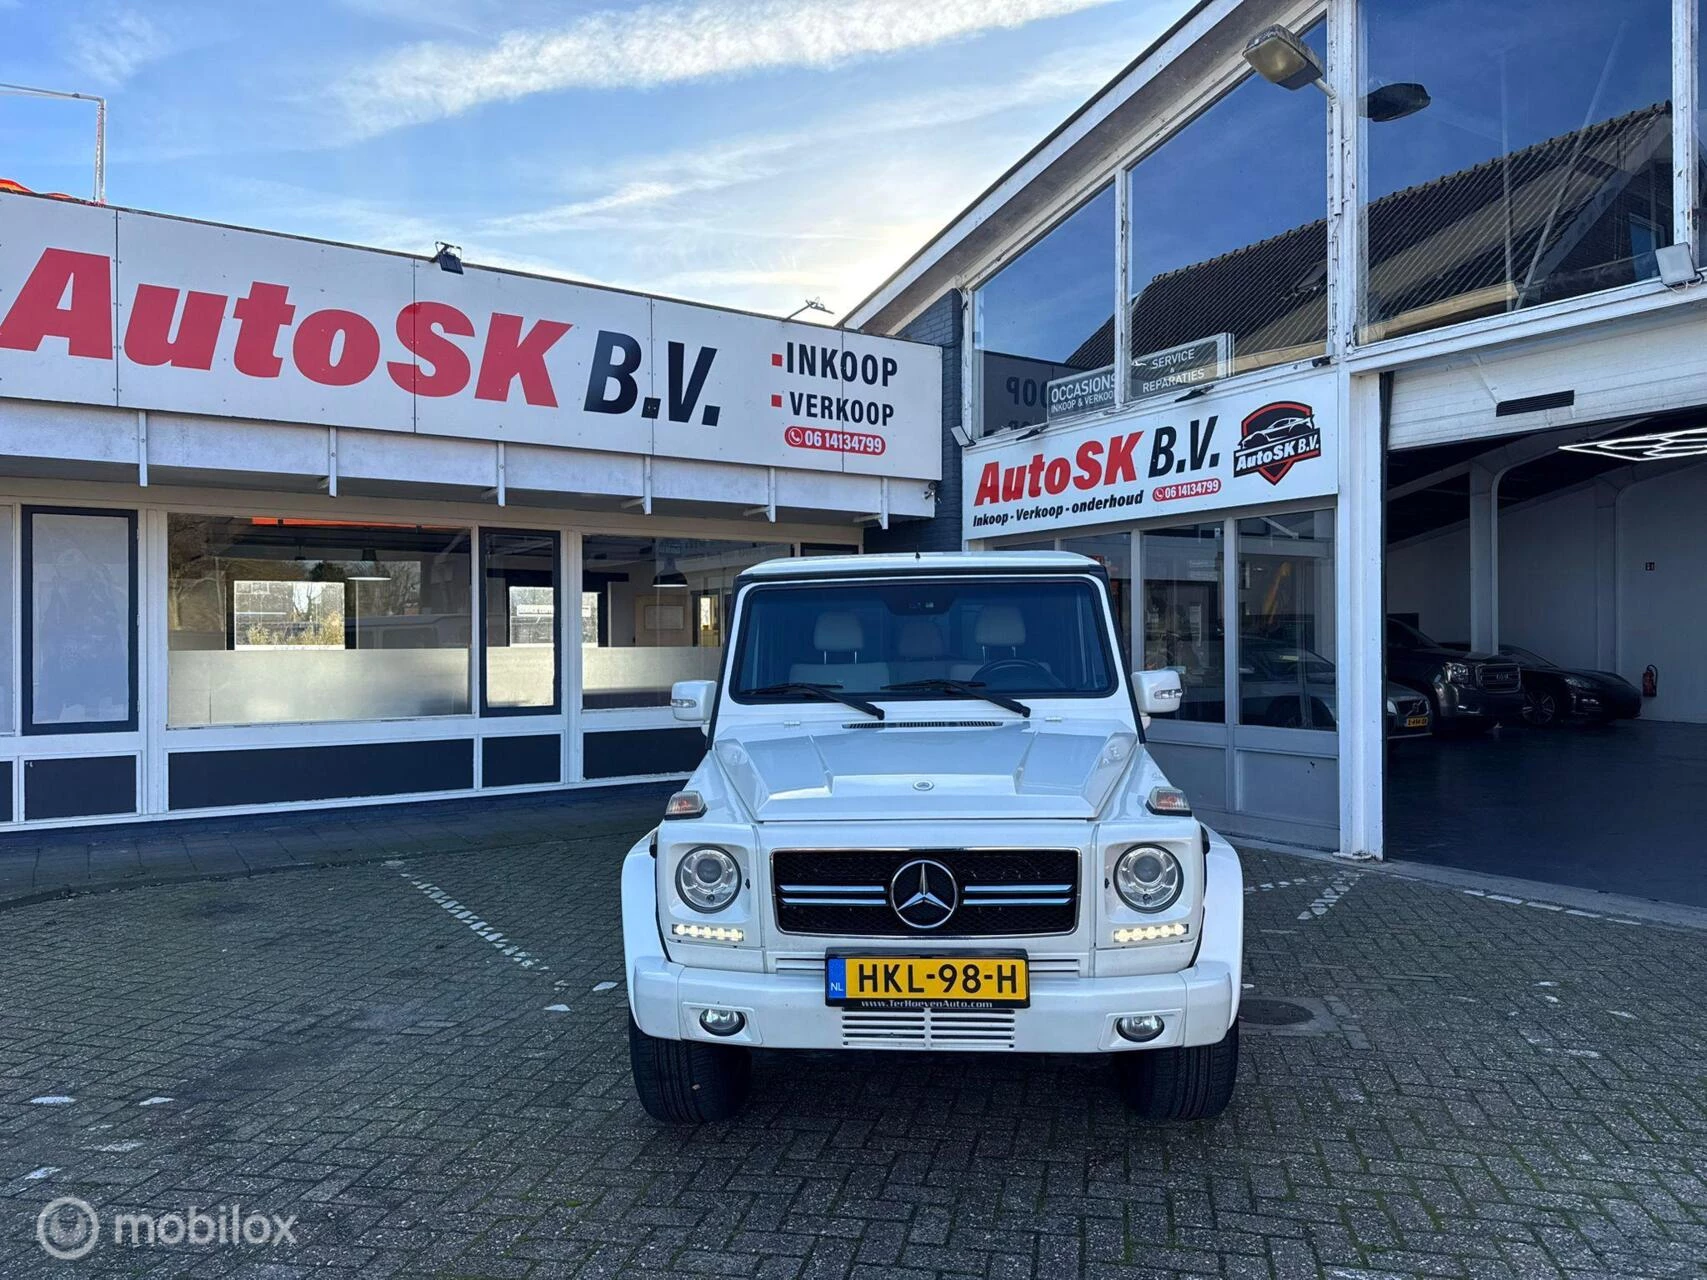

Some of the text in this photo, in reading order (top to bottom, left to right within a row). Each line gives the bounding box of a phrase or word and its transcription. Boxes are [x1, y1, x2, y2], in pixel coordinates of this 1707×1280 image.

[0, 247, 721, 426] AutoSK B.V.
[786, 341, 898, 387] INKOOP
[1151, 348, 1195, 369] SERVICE
[1142, 368, 1205, 393] REPARATIES
[789, 391, 895, 426] VERKOOP
[1078, 397, 1084, 407] &
[1084, 391, 1114, 405] VERKOO
[804, 428, 882, 453] 06 14134799
[1235, 434, 1320, 472] AutoSK B.V.
[974, 415, 1220, 507] AutoSK B.V.
[1164, 479, 1220, 498] 06 14134799
[973, 514, 1008, 527] Inkoop
[1016, 505, 1063, 522] Verkoop
[1071, 490, 1144, 513] onderhoud
[830, 982, 844, 992] NL
[858, 963, 1017, 994] HKL-98-H
[861, 999, 993, 1009] www.TerHoevenAuto.com
